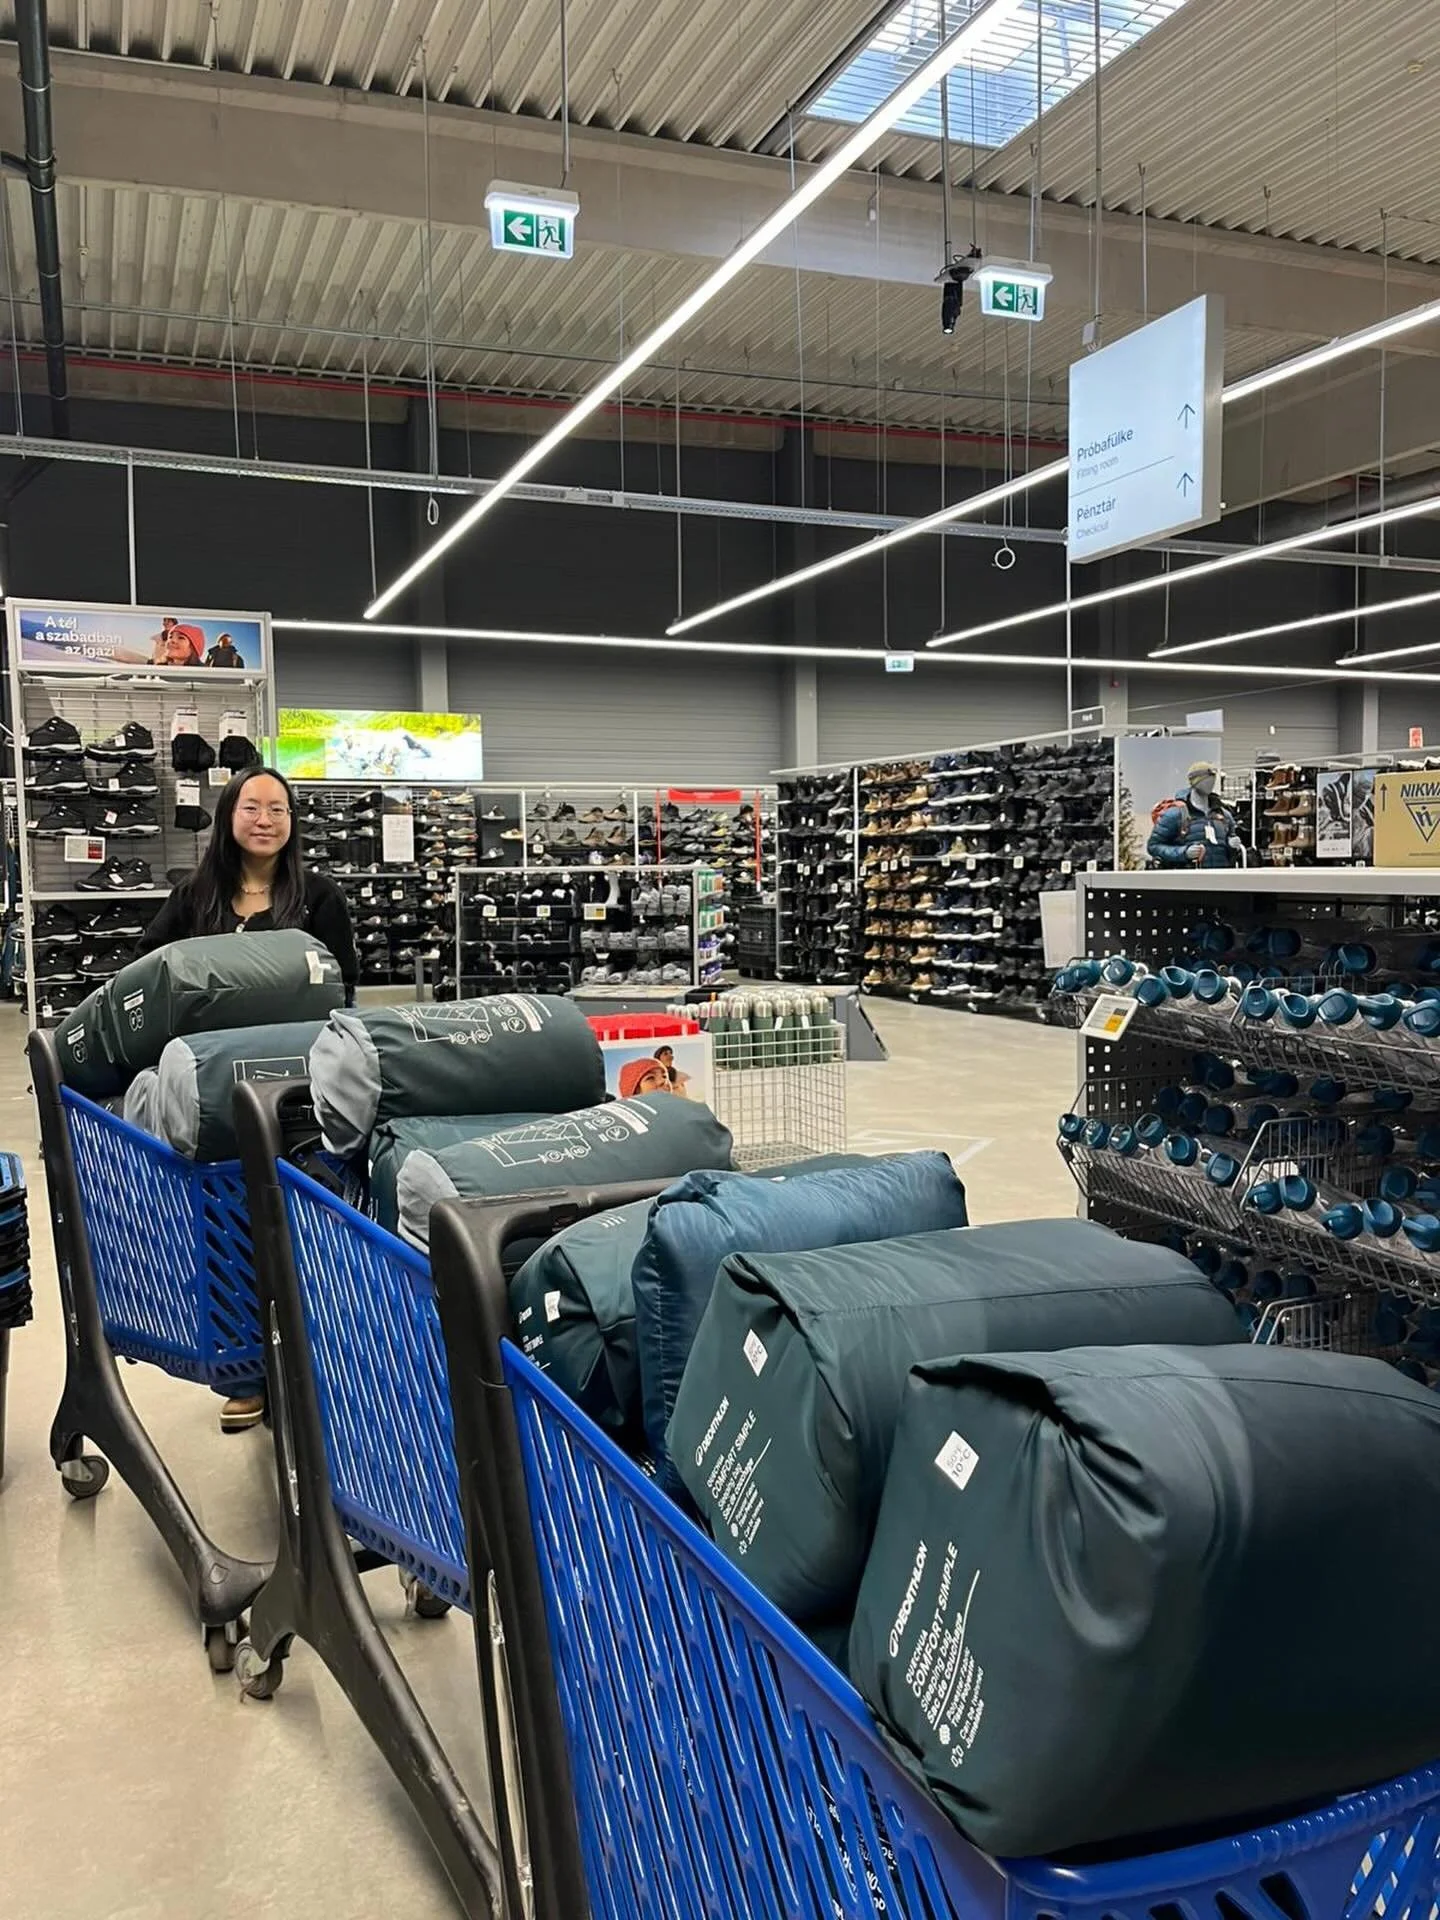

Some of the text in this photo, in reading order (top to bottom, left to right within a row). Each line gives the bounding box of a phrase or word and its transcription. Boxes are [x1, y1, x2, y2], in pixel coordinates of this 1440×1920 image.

[1076, 497, 1116, 522] Pénztár
[35, 630, 122, 644] a szabadban
[45, 616, 77, 629] A tél
[65, 644, 115, 657] az igazi
[701, 1395, 729, 1453] DECATHLON
[712, 1410, 756, 1499] COMFORT SIMPLE
[895, 1540, 929, 1635] DECATHLON
[912, 1541, 958, 1699] COMFORT SIMPLE
[905, 1629, 929, 1684] QUECHUA
[921, 1629, 954, 1713] Sleeping bag
[926, 1612, 963, 1724] Sac de couchage
